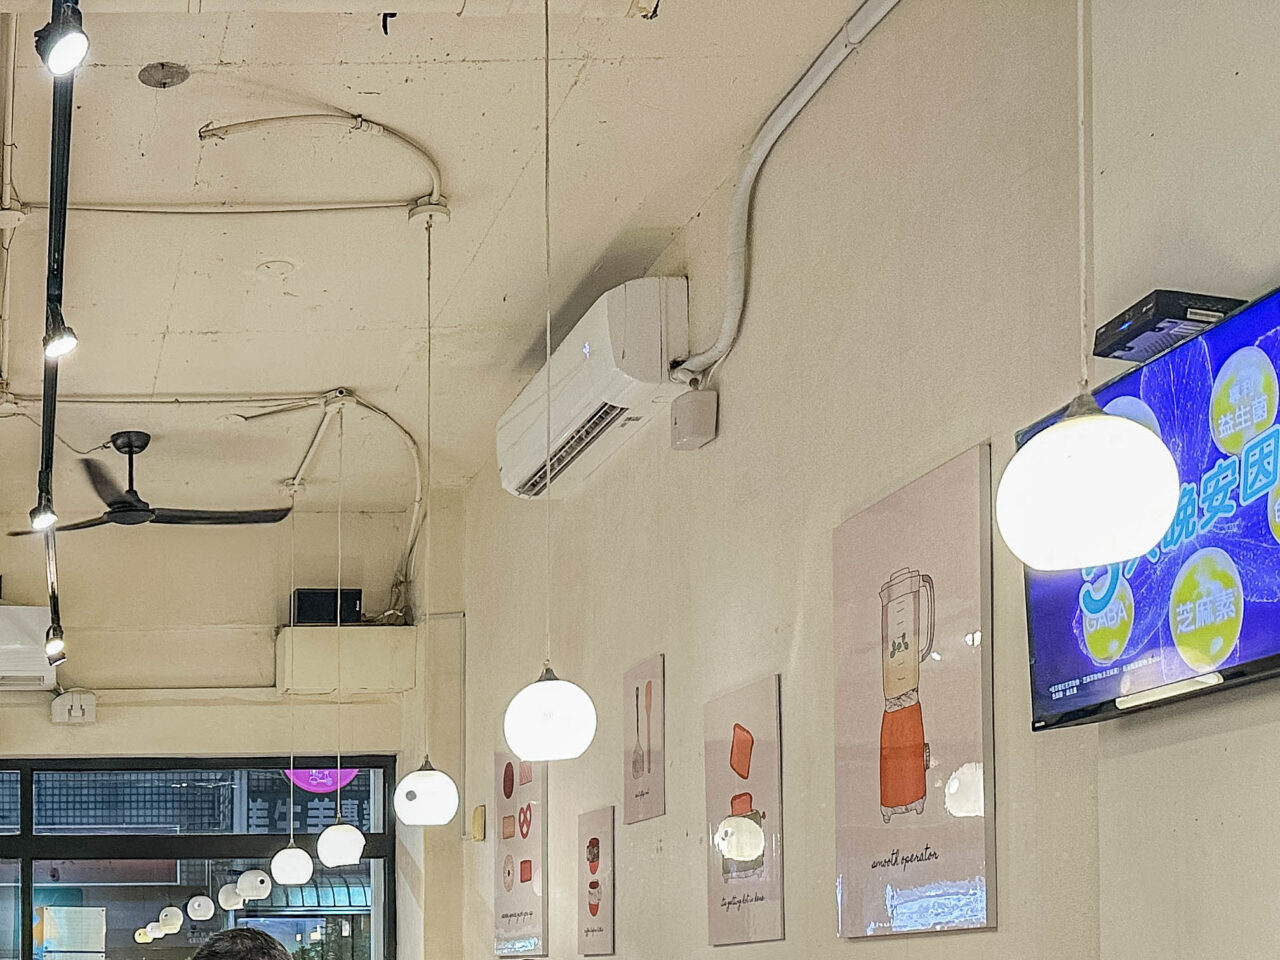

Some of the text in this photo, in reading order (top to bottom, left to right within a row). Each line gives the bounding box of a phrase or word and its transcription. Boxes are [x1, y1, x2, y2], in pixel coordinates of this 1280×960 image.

[1218, 394, 1268, 438] 益生菌
[1086, 601, 1128, 633] GABA
[1176, 589, 1236, 634] 芝麻素
[871, 843, 940, 872] smooth operator
